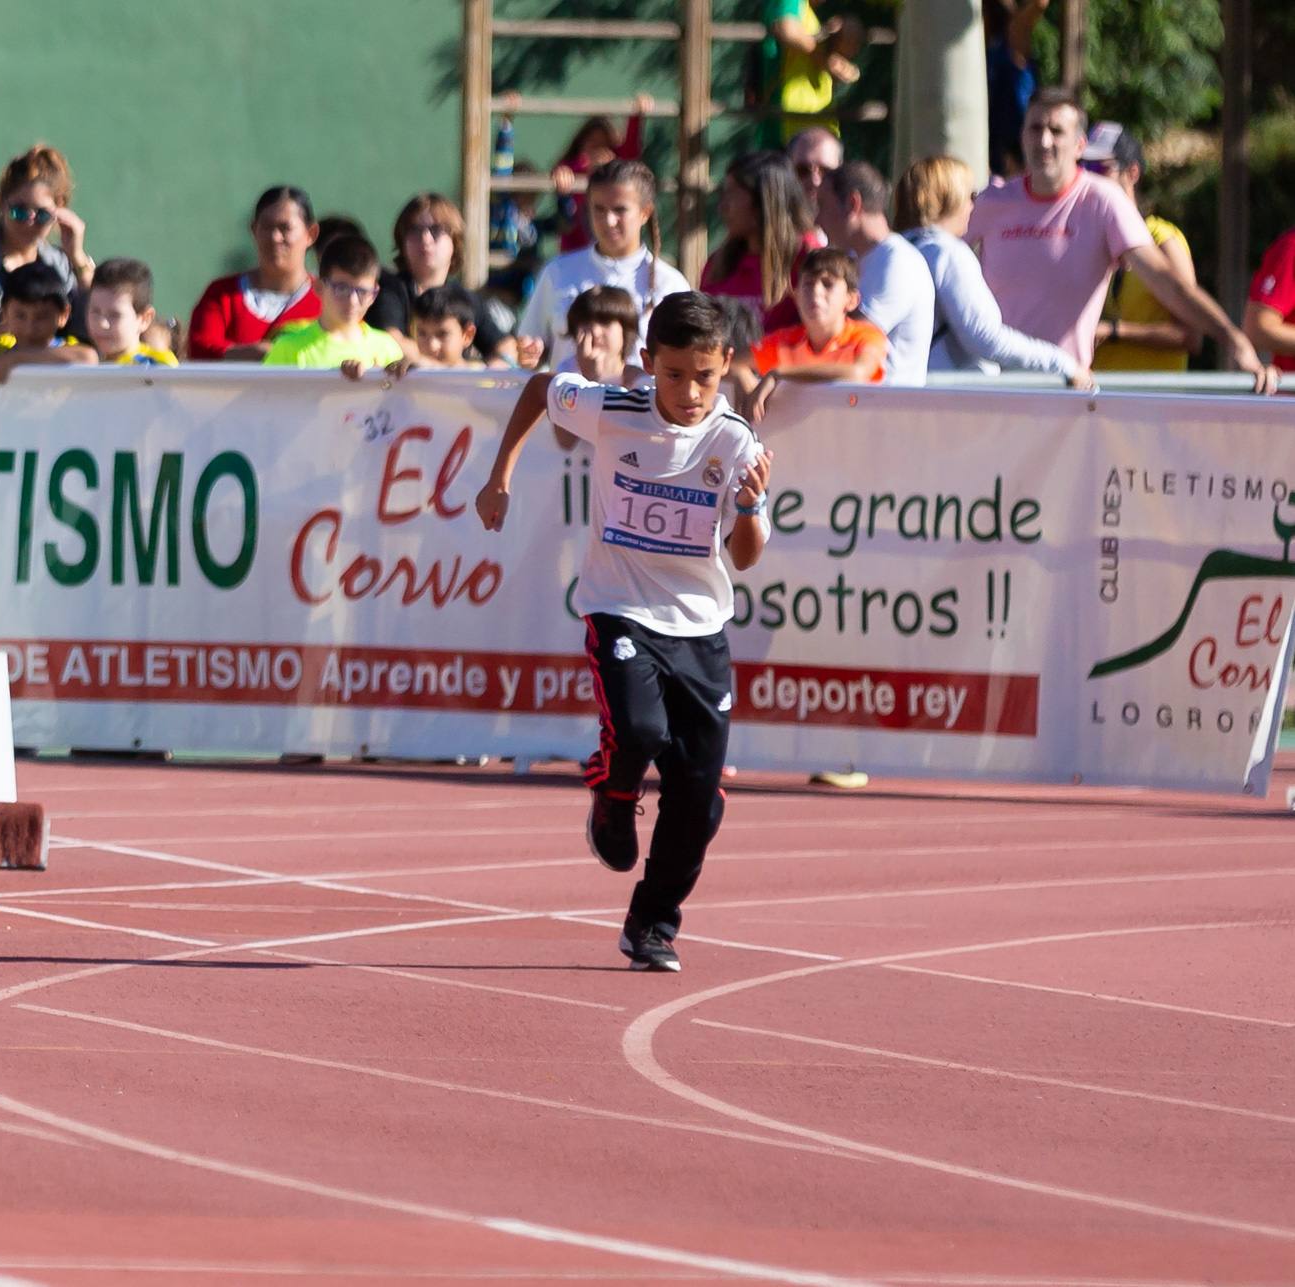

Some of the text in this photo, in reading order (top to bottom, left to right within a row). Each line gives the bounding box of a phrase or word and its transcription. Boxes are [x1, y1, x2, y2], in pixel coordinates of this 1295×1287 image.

[376, 424, 474, 527] El
[641, 483, 710, 506] HEMAFIX
[1105, 467, 1290, 501] ATLETISMO
[617, 496, 693, 541] 161
[826, 474, 1043, 559] grande
[1099, 487, 1122, 604] CLUB DE
[289, 505, 504, 611] Corvo
[1234, 592, 1284, 650] El
[60, 646, 303, 691] ATLETISMO
[320, 649, 488, 701] Aprende
[498, 665, 521, 709] y
[750, 666, 897, 720] deporte
[908, 680, 968, 729] rey
